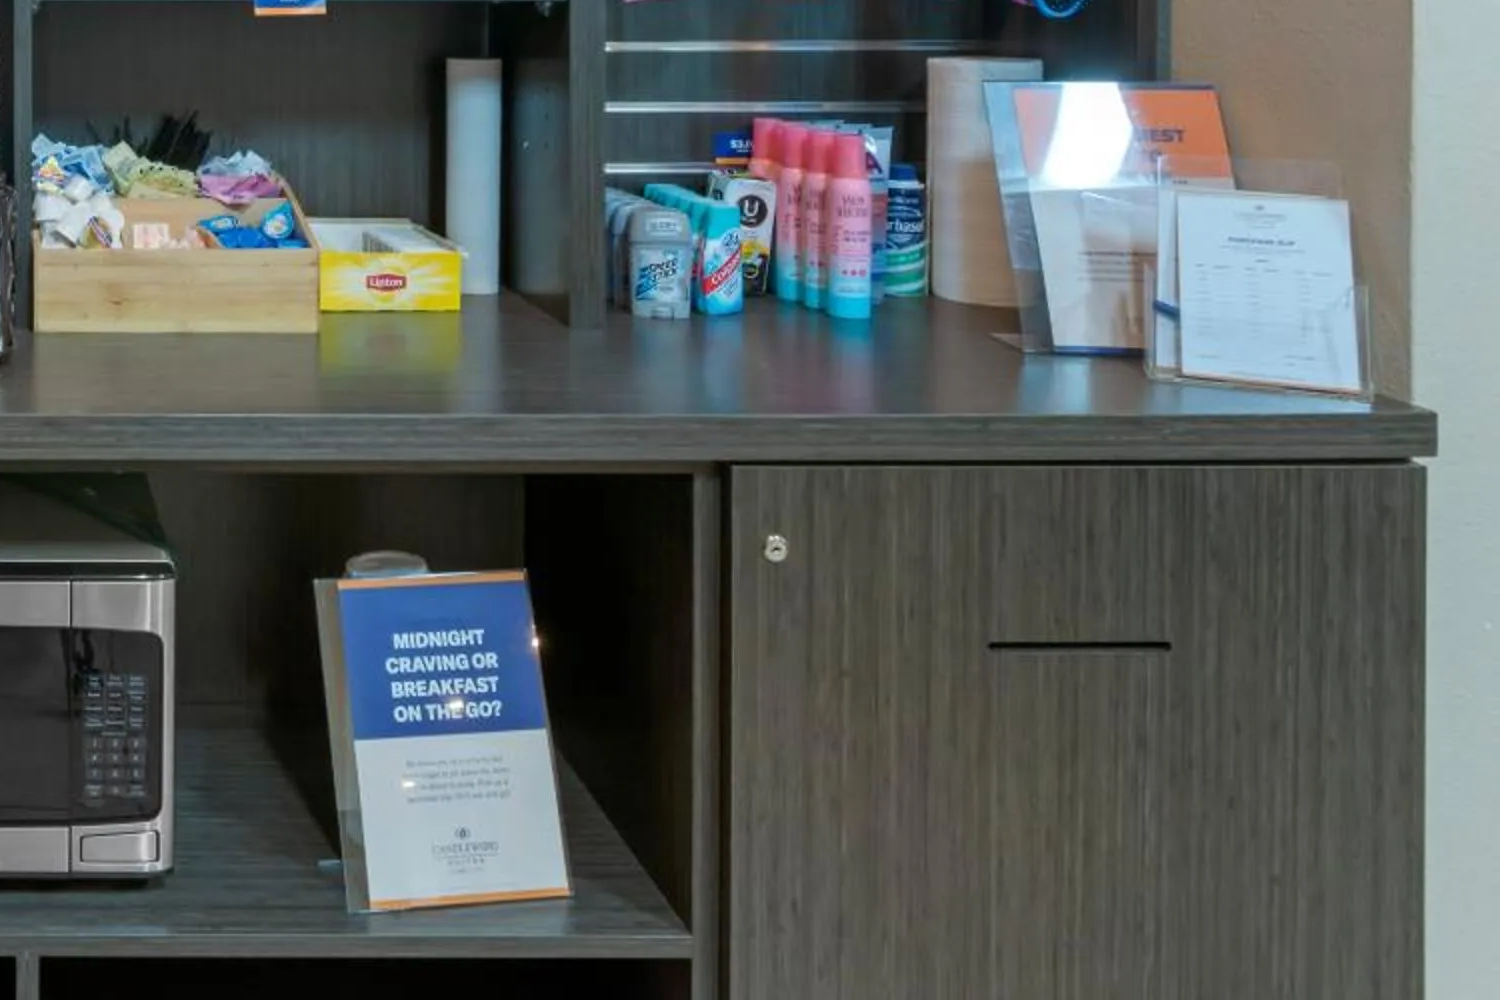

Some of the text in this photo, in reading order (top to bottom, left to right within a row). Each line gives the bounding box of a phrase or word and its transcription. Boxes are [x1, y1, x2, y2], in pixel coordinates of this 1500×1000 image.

[368, 275, 404, 289] Lipton
[393, 628, 486, 650] MIDNIGHT
[385, 652, 499, 675] CRAVING OR
[391, 675, 500, 700] BREAKFAST
[393, 699, 503, 724] ON THE GO?
